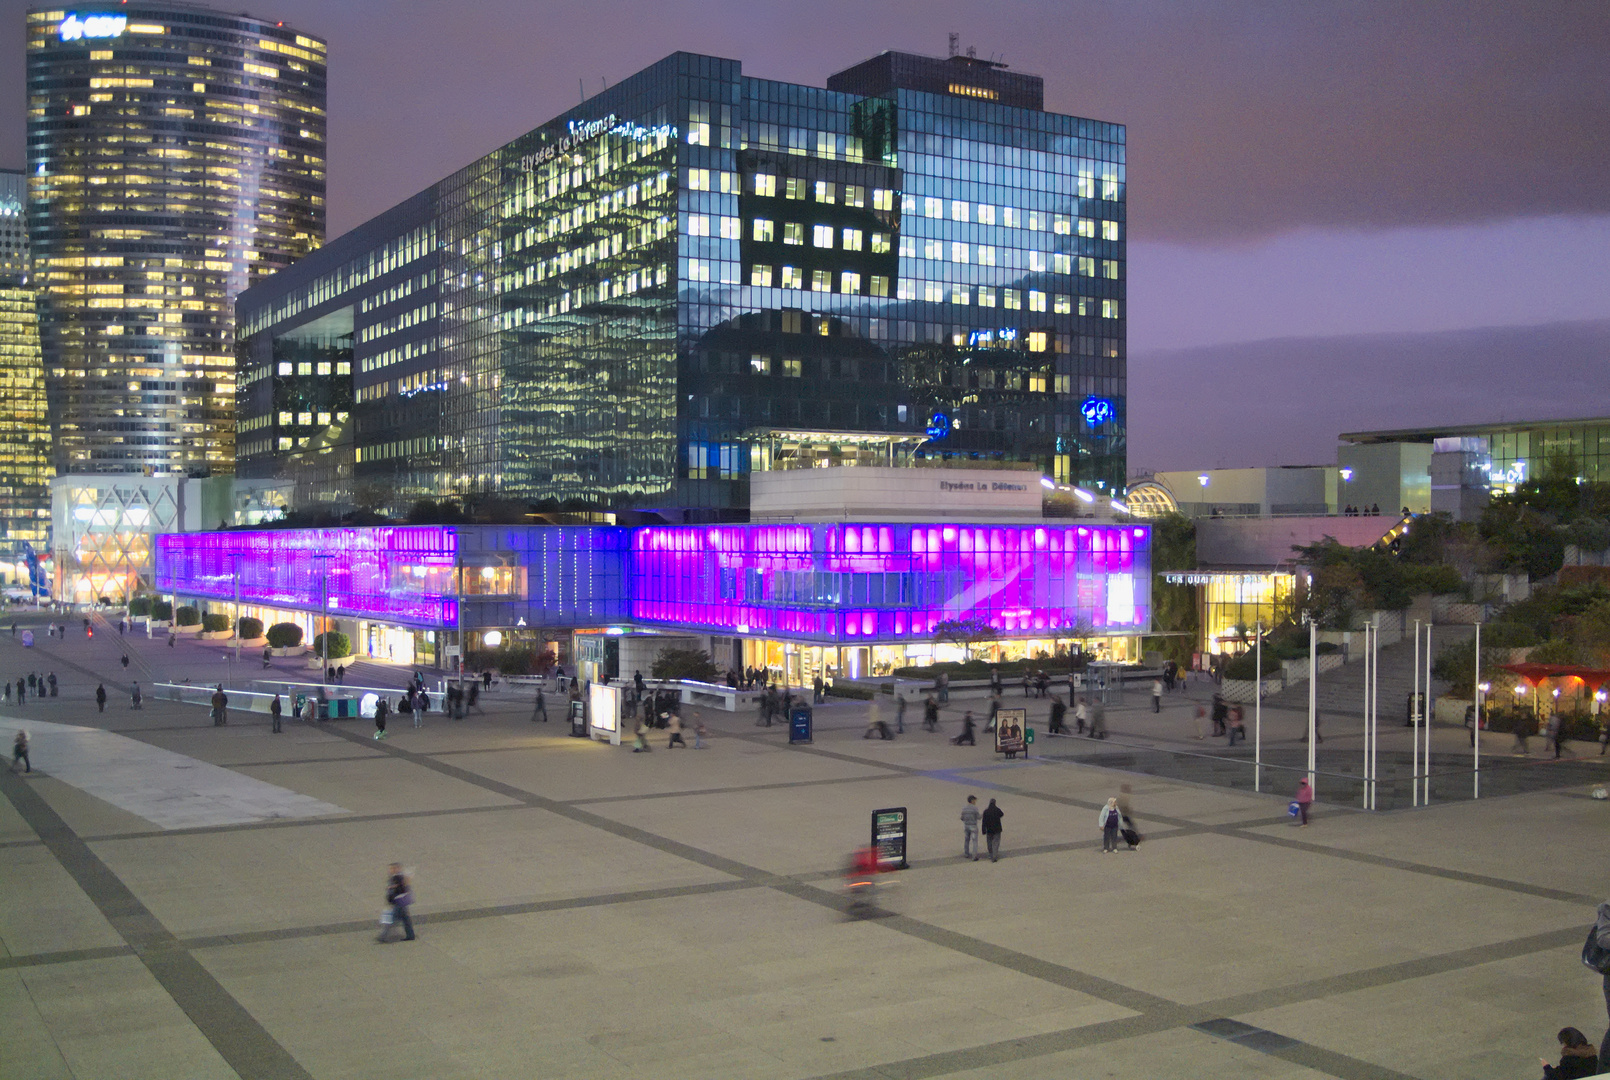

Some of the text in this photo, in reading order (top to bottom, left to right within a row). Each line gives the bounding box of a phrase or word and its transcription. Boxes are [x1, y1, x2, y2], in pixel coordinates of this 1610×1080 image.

[558, 137, 570, 154] La
[572, 113, 615, 148] Défense
[977, 482, 988, 491] La
